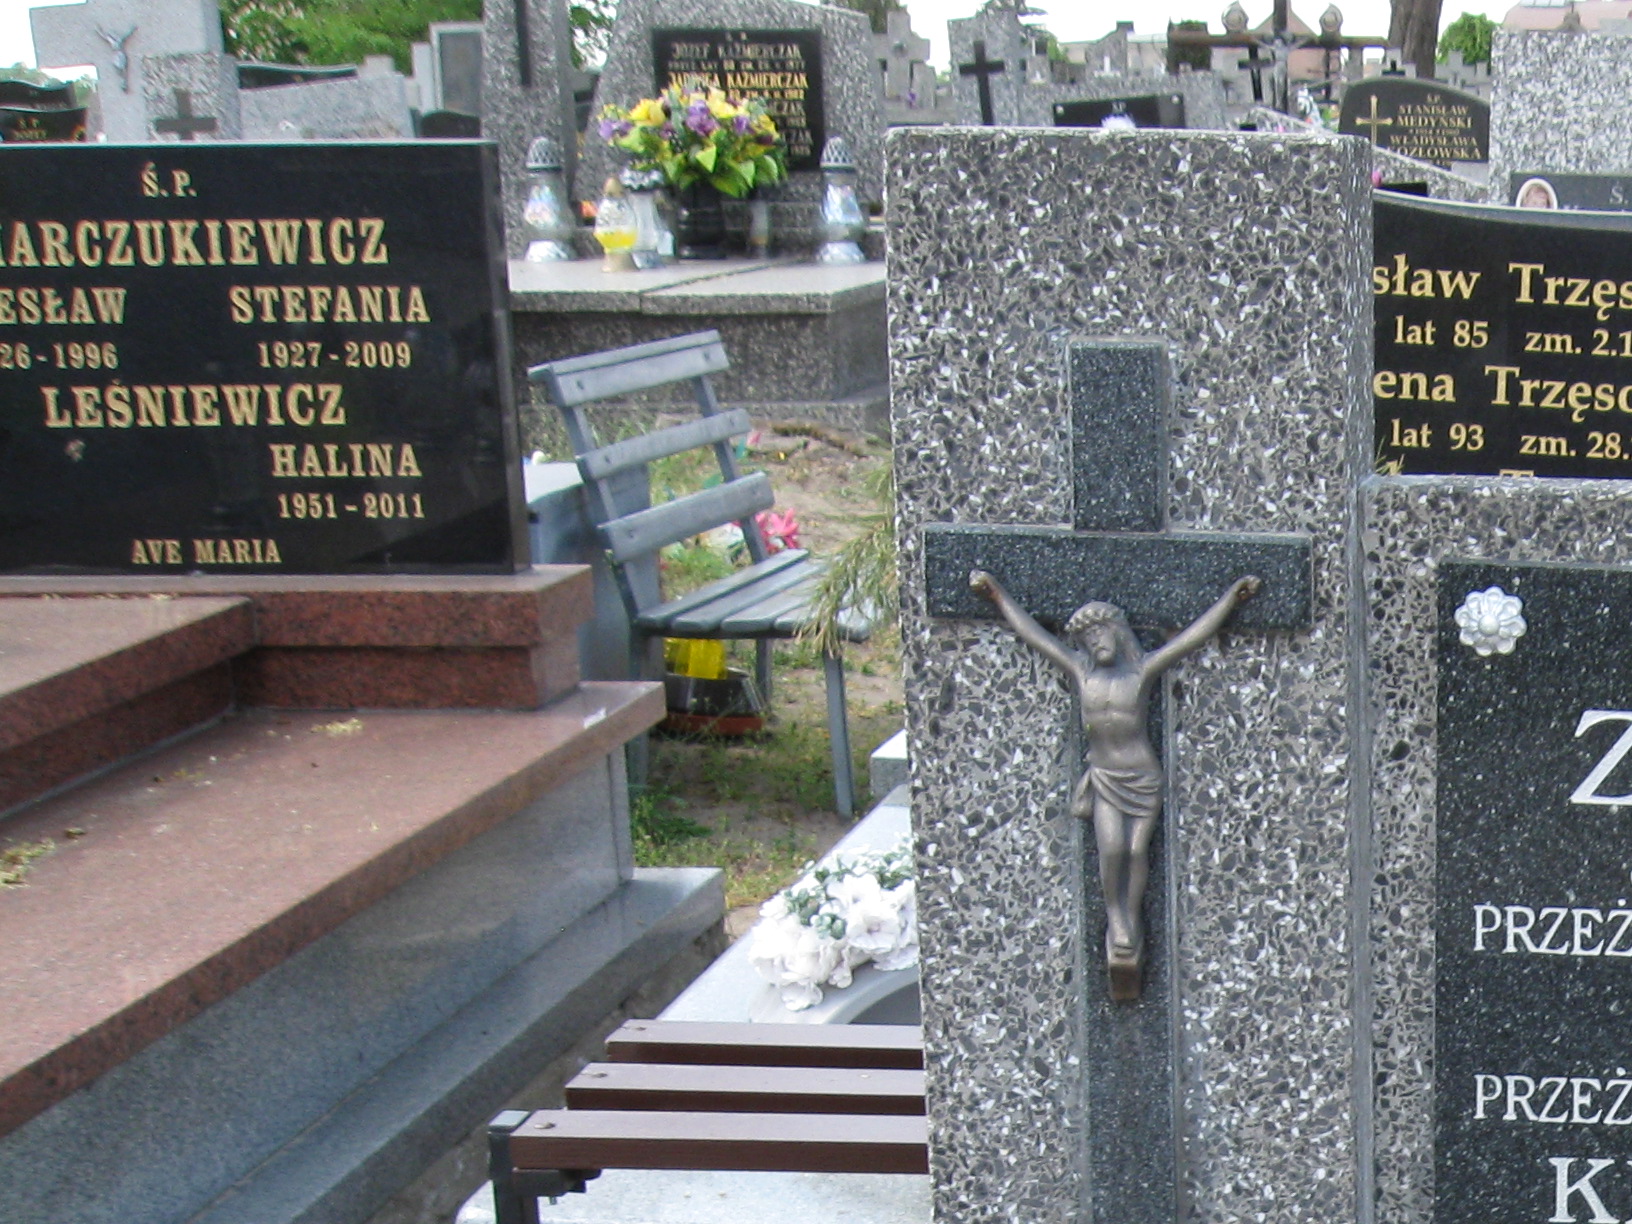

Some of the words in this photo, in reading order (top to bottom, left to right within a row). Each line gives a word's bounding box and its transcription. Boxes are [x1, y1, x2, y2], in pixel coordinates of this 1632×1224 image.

[1399, 104, 1469, 116] STANISŁAW
[1388, 146, 1482, 160] OZŁOWSKA
[0, 217, 389, 268] ARCZUKIEWICZ
[229, 285, 431, 324] STEFANIA
[1394, 315, 1437, 346] lat
[1453, 318, 1489, 350] 85
[1524, 329, 1583, 356] zm.
[40, 379, 347, 429] LEŚNIEWICZ
[1390, 418, 1432, 449] lat
[1449, 423, 1485, 451] 93
[1519, 434, 1577, 458] zm.
[269, 443, 423, 479] HALINA
[132, 539, 183, 565] AVE
[193, 538, 283, 564] MARIA
